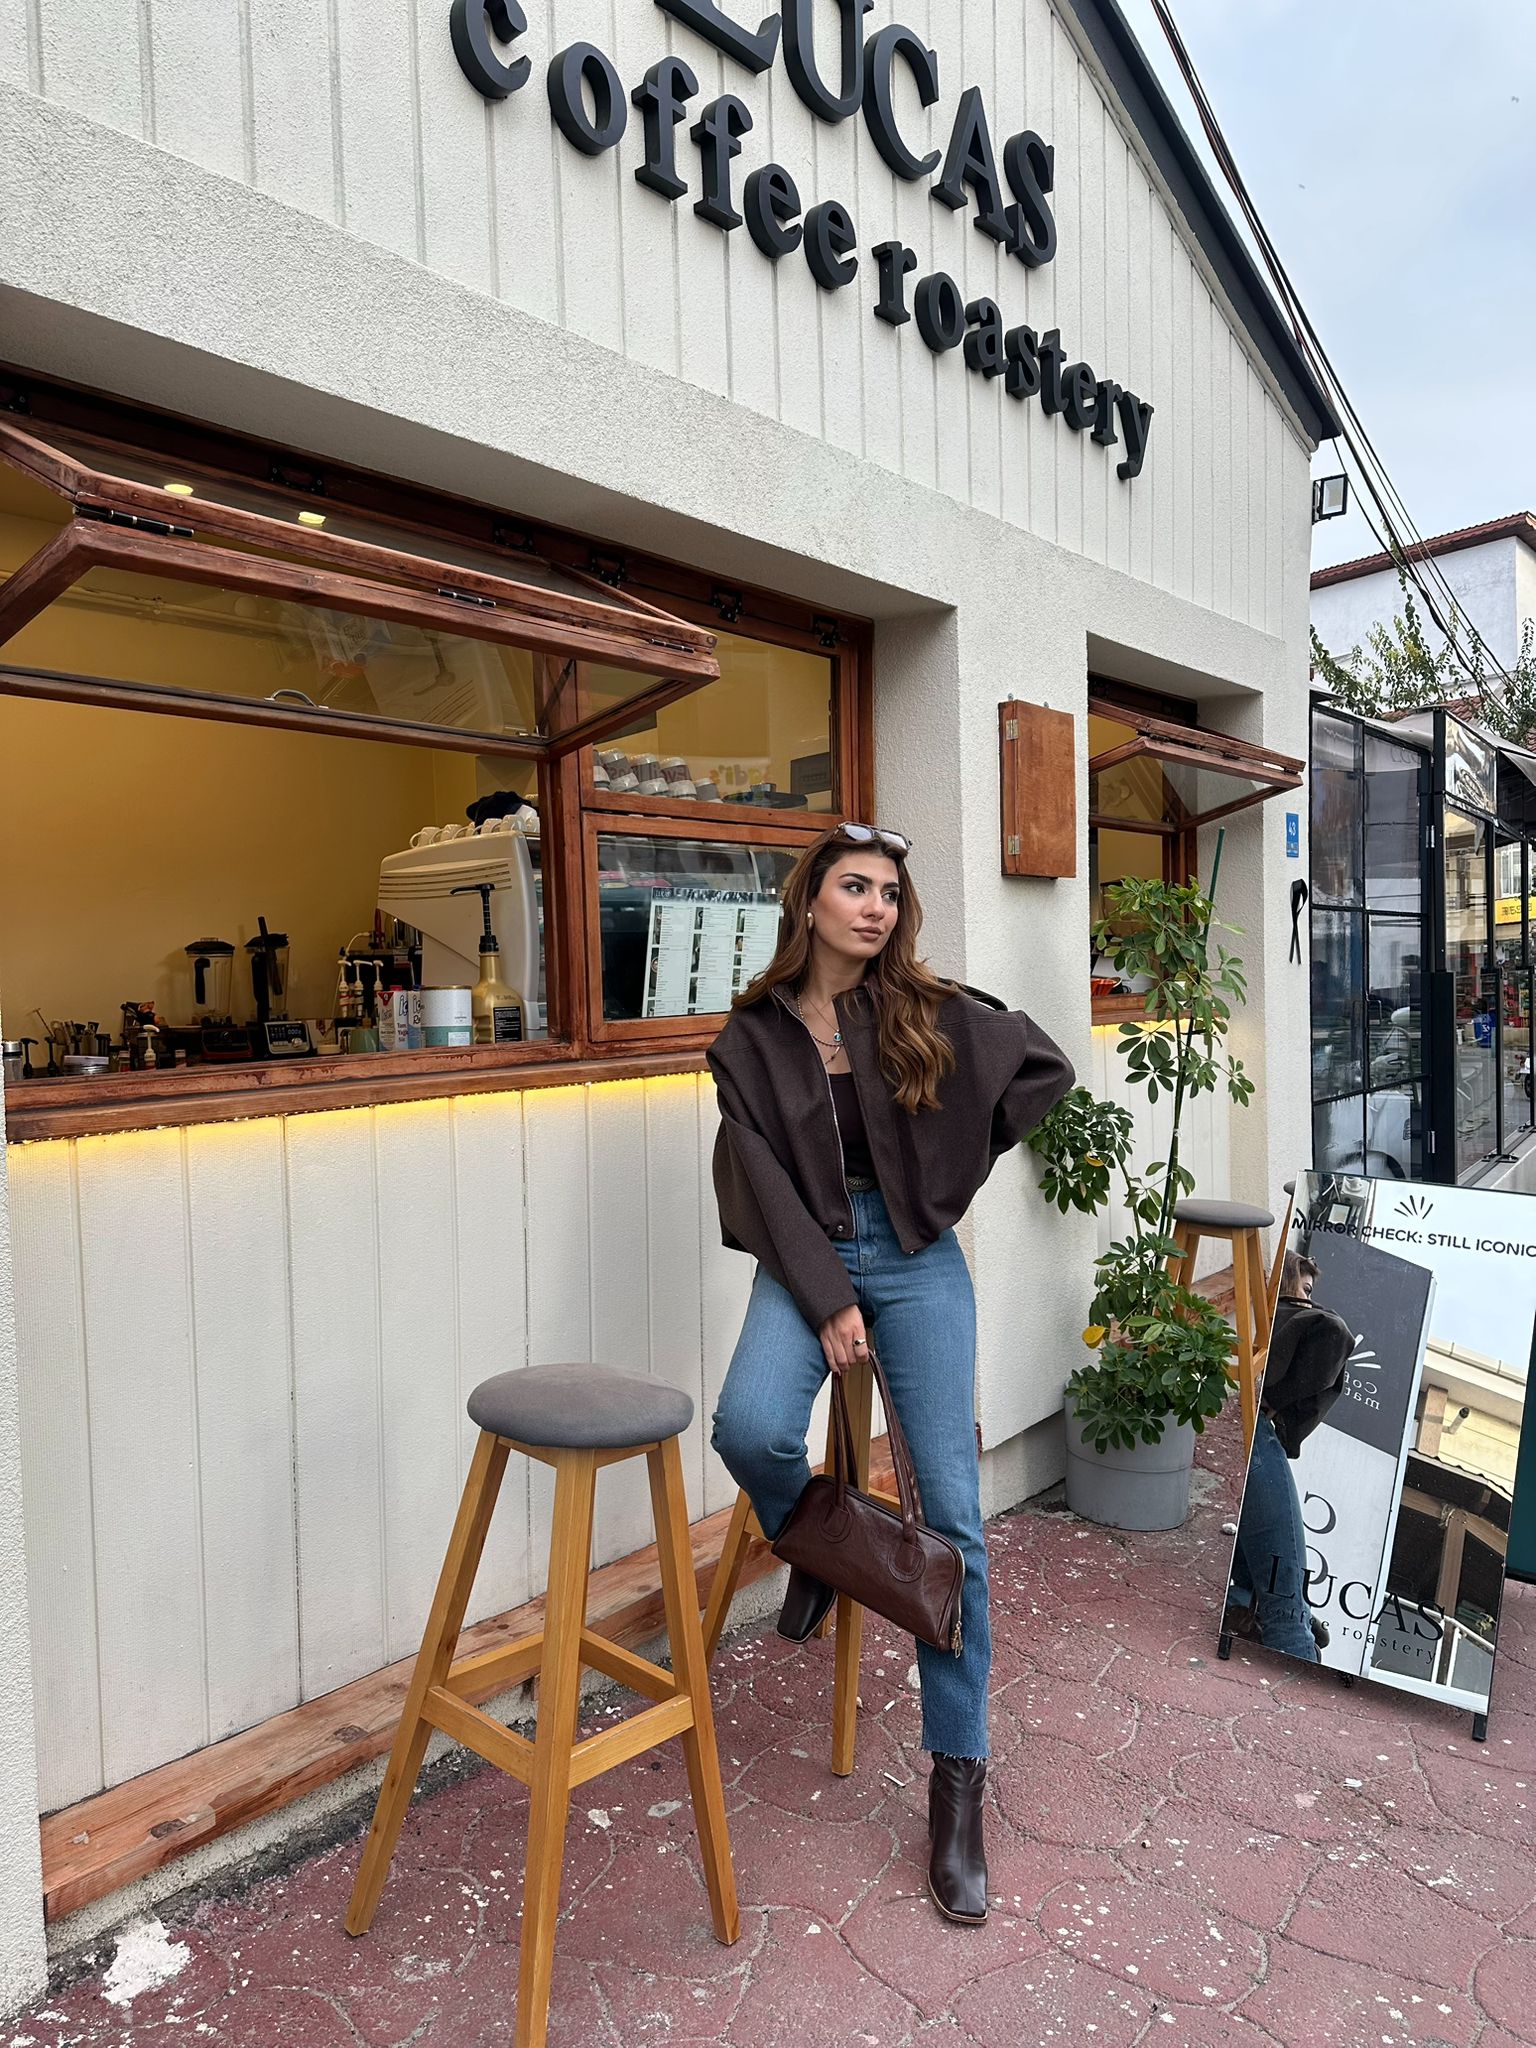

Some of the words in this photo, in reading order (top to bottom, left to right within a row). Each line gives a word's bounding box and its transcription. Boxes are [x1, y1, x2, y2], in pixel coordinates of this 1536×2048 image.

[449, 0, 859, 290] coffee
[872, 241, 1155, 480] roastery
[1291, 1217, 1358, 1237] MIRROR
[1361, 1225, 1423, 1245] CHECK:
[1427, 1233, 1471, 1250] STILL
[1476, 1239, 1536, 1258] ICONIC
[1266, 1554, 1446, 1642] LUCAS
[1264, 1606, 1330, 1631] coffee
[1342, 1627, 1437, 1665] roastery
